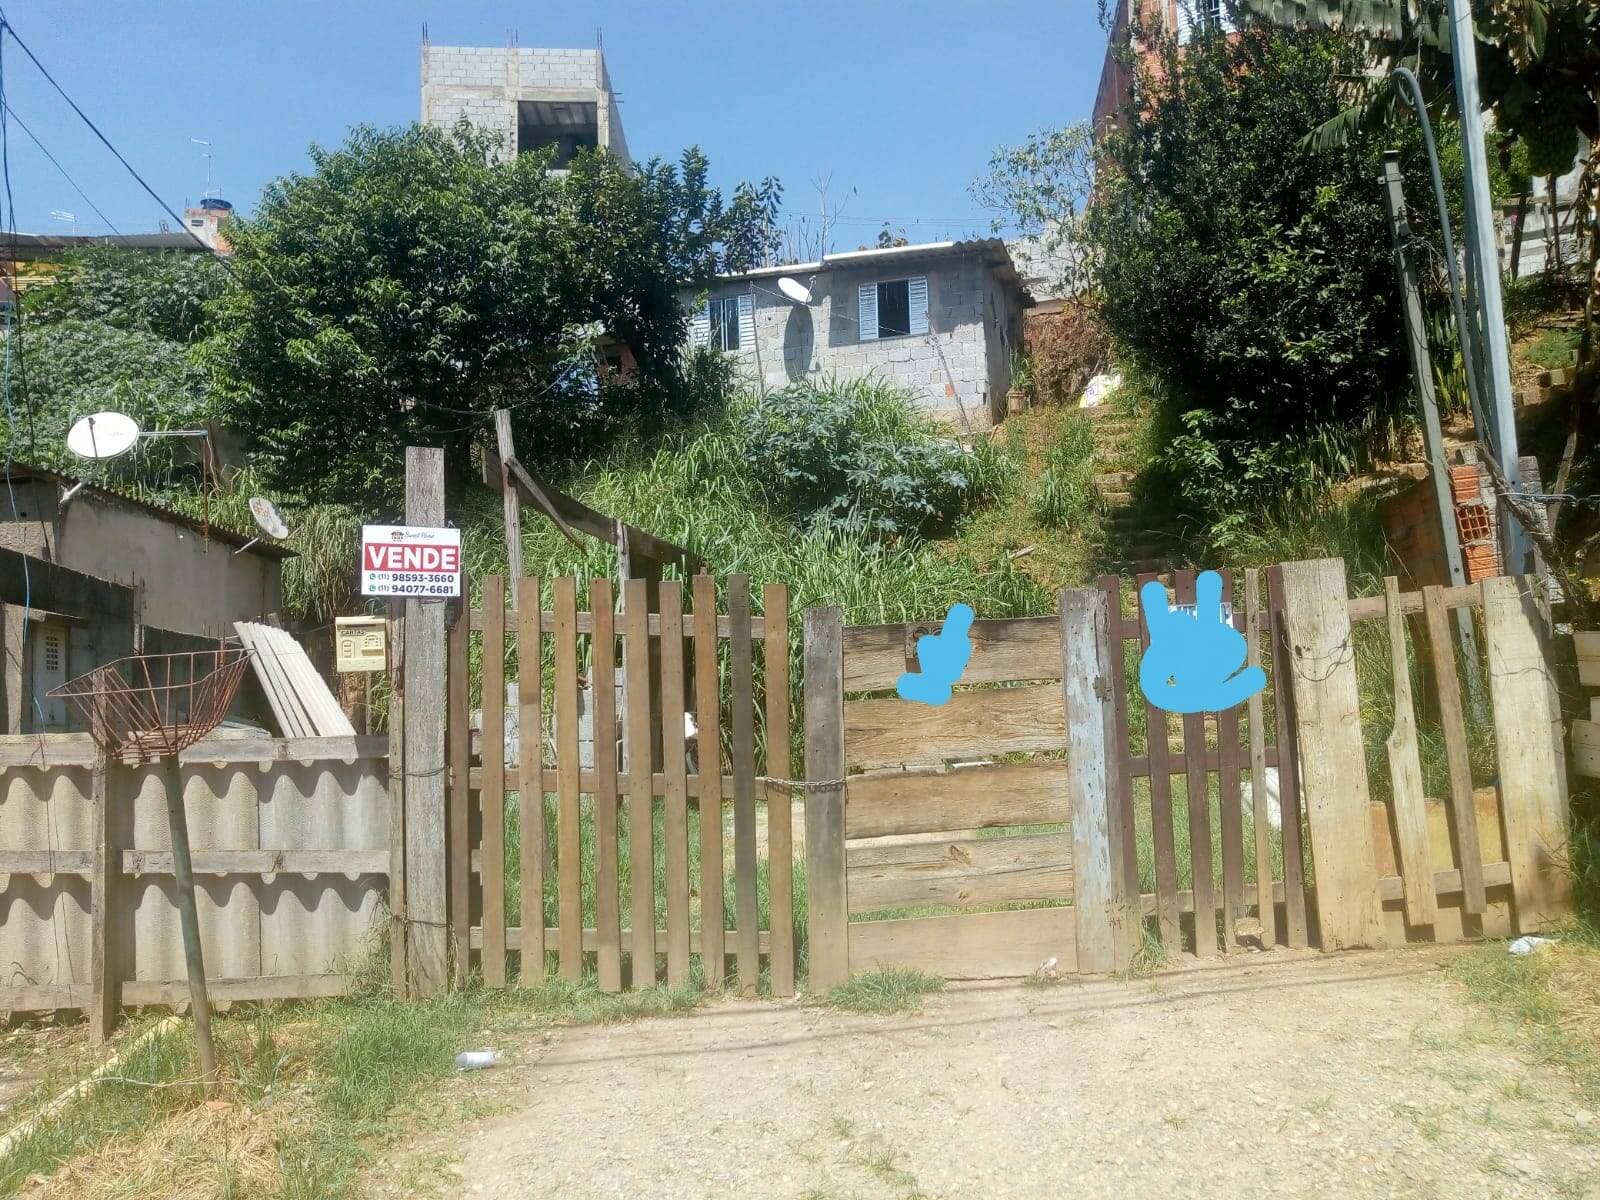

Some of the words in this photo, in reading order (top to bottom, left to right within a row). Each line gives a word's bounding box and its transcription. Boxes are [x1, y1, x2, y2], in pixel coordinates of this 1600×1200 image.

[368, 545, 456, 570] VENDE
[378, 573, 390, 581] (11)
[392, 573, 454, 583] 98593-3660
[392, 585, 454, 594] 94077-6681
